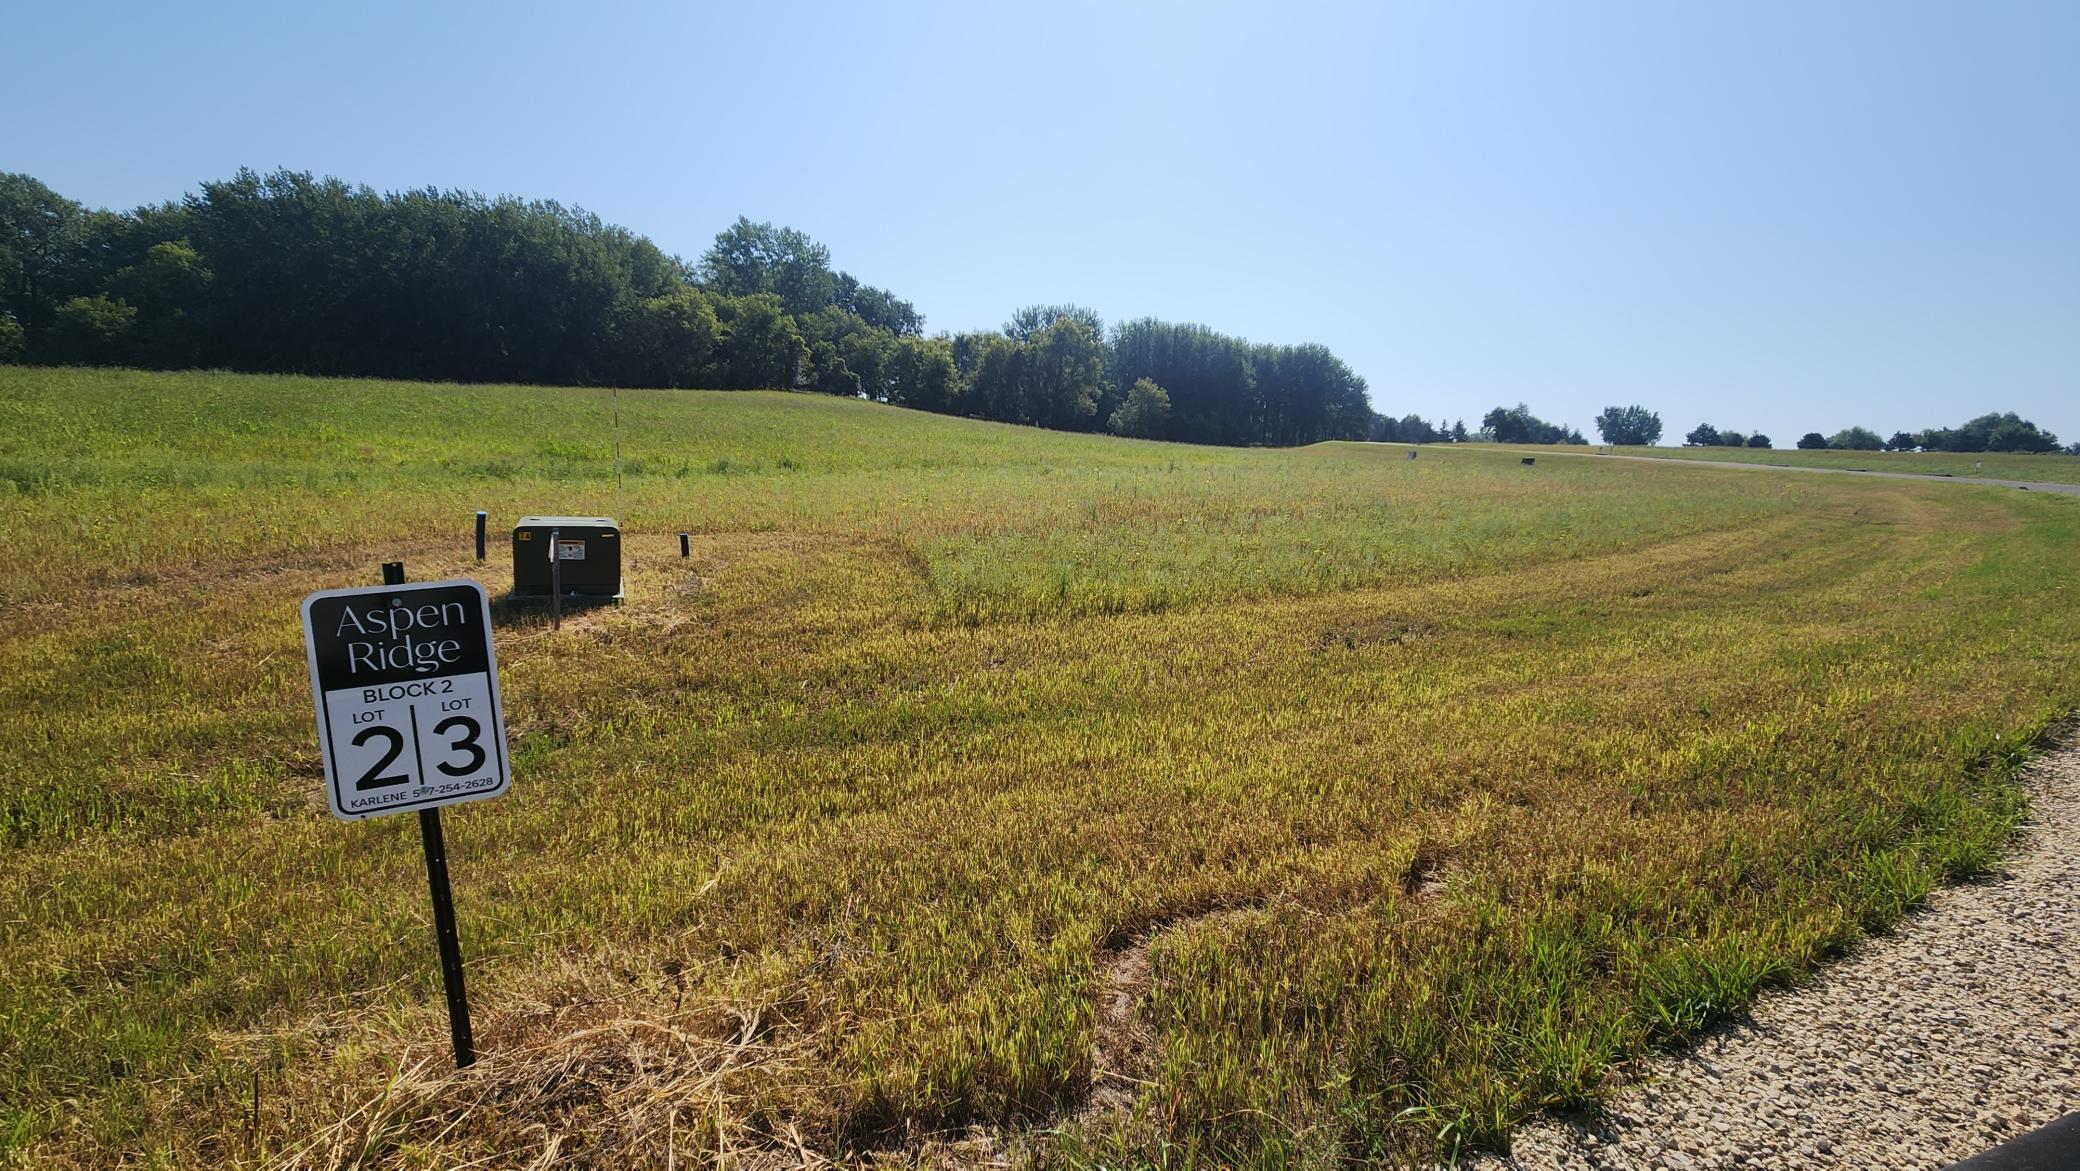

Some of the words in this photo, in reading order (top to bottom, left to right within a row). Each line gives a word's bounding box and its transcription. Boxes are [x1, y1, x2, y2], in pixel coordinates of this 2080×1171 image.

[336, 602, 465, 640] Aspen
[348, 634, 461, 674] Ridge
[363, 681, 436, 703] BLOCK
[440, 679, 454, 693] 2
[441, 698, 472, 712] LOT
[352, 709, 385, 724] LOT
[351, 725, 410, 791] 2
[432, 715, 486, 777] 3
[350, 791, 407, 808] KARLENE
[412, 777, 494, 798] 57-254-2628
